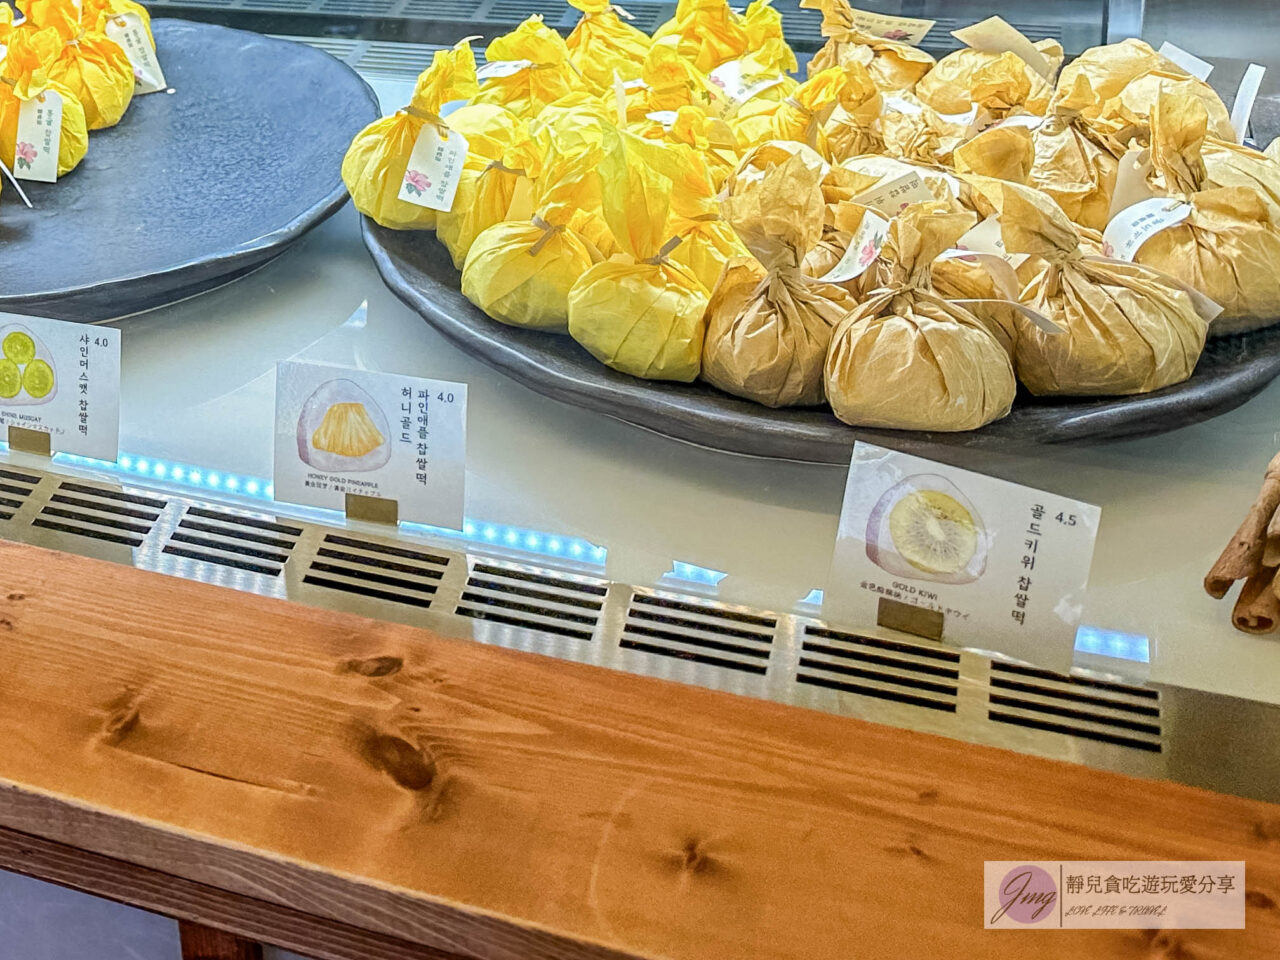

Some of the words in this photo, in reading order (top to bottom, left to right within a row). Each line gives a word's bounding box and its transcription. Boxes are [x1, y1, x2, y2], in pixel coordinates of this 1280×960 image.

[94, 337, 109, 347] 4.0
[78, 333, 90, 395] 샤인머스캣
[400, 387, 412, 443] 허니골드
[437, 392, 455, 403] 4.0
[78, 399, 89, 436] 찹쌀떡
[1021, 503, 1046, 570] 골드키위
[1055, 511, 1077, 527] 4.5
[892, 581, 917, 594] GOLD
[918, 590, 938, 601] KIWI
[1011, 575, 1033, 626] 찹쌀떡
